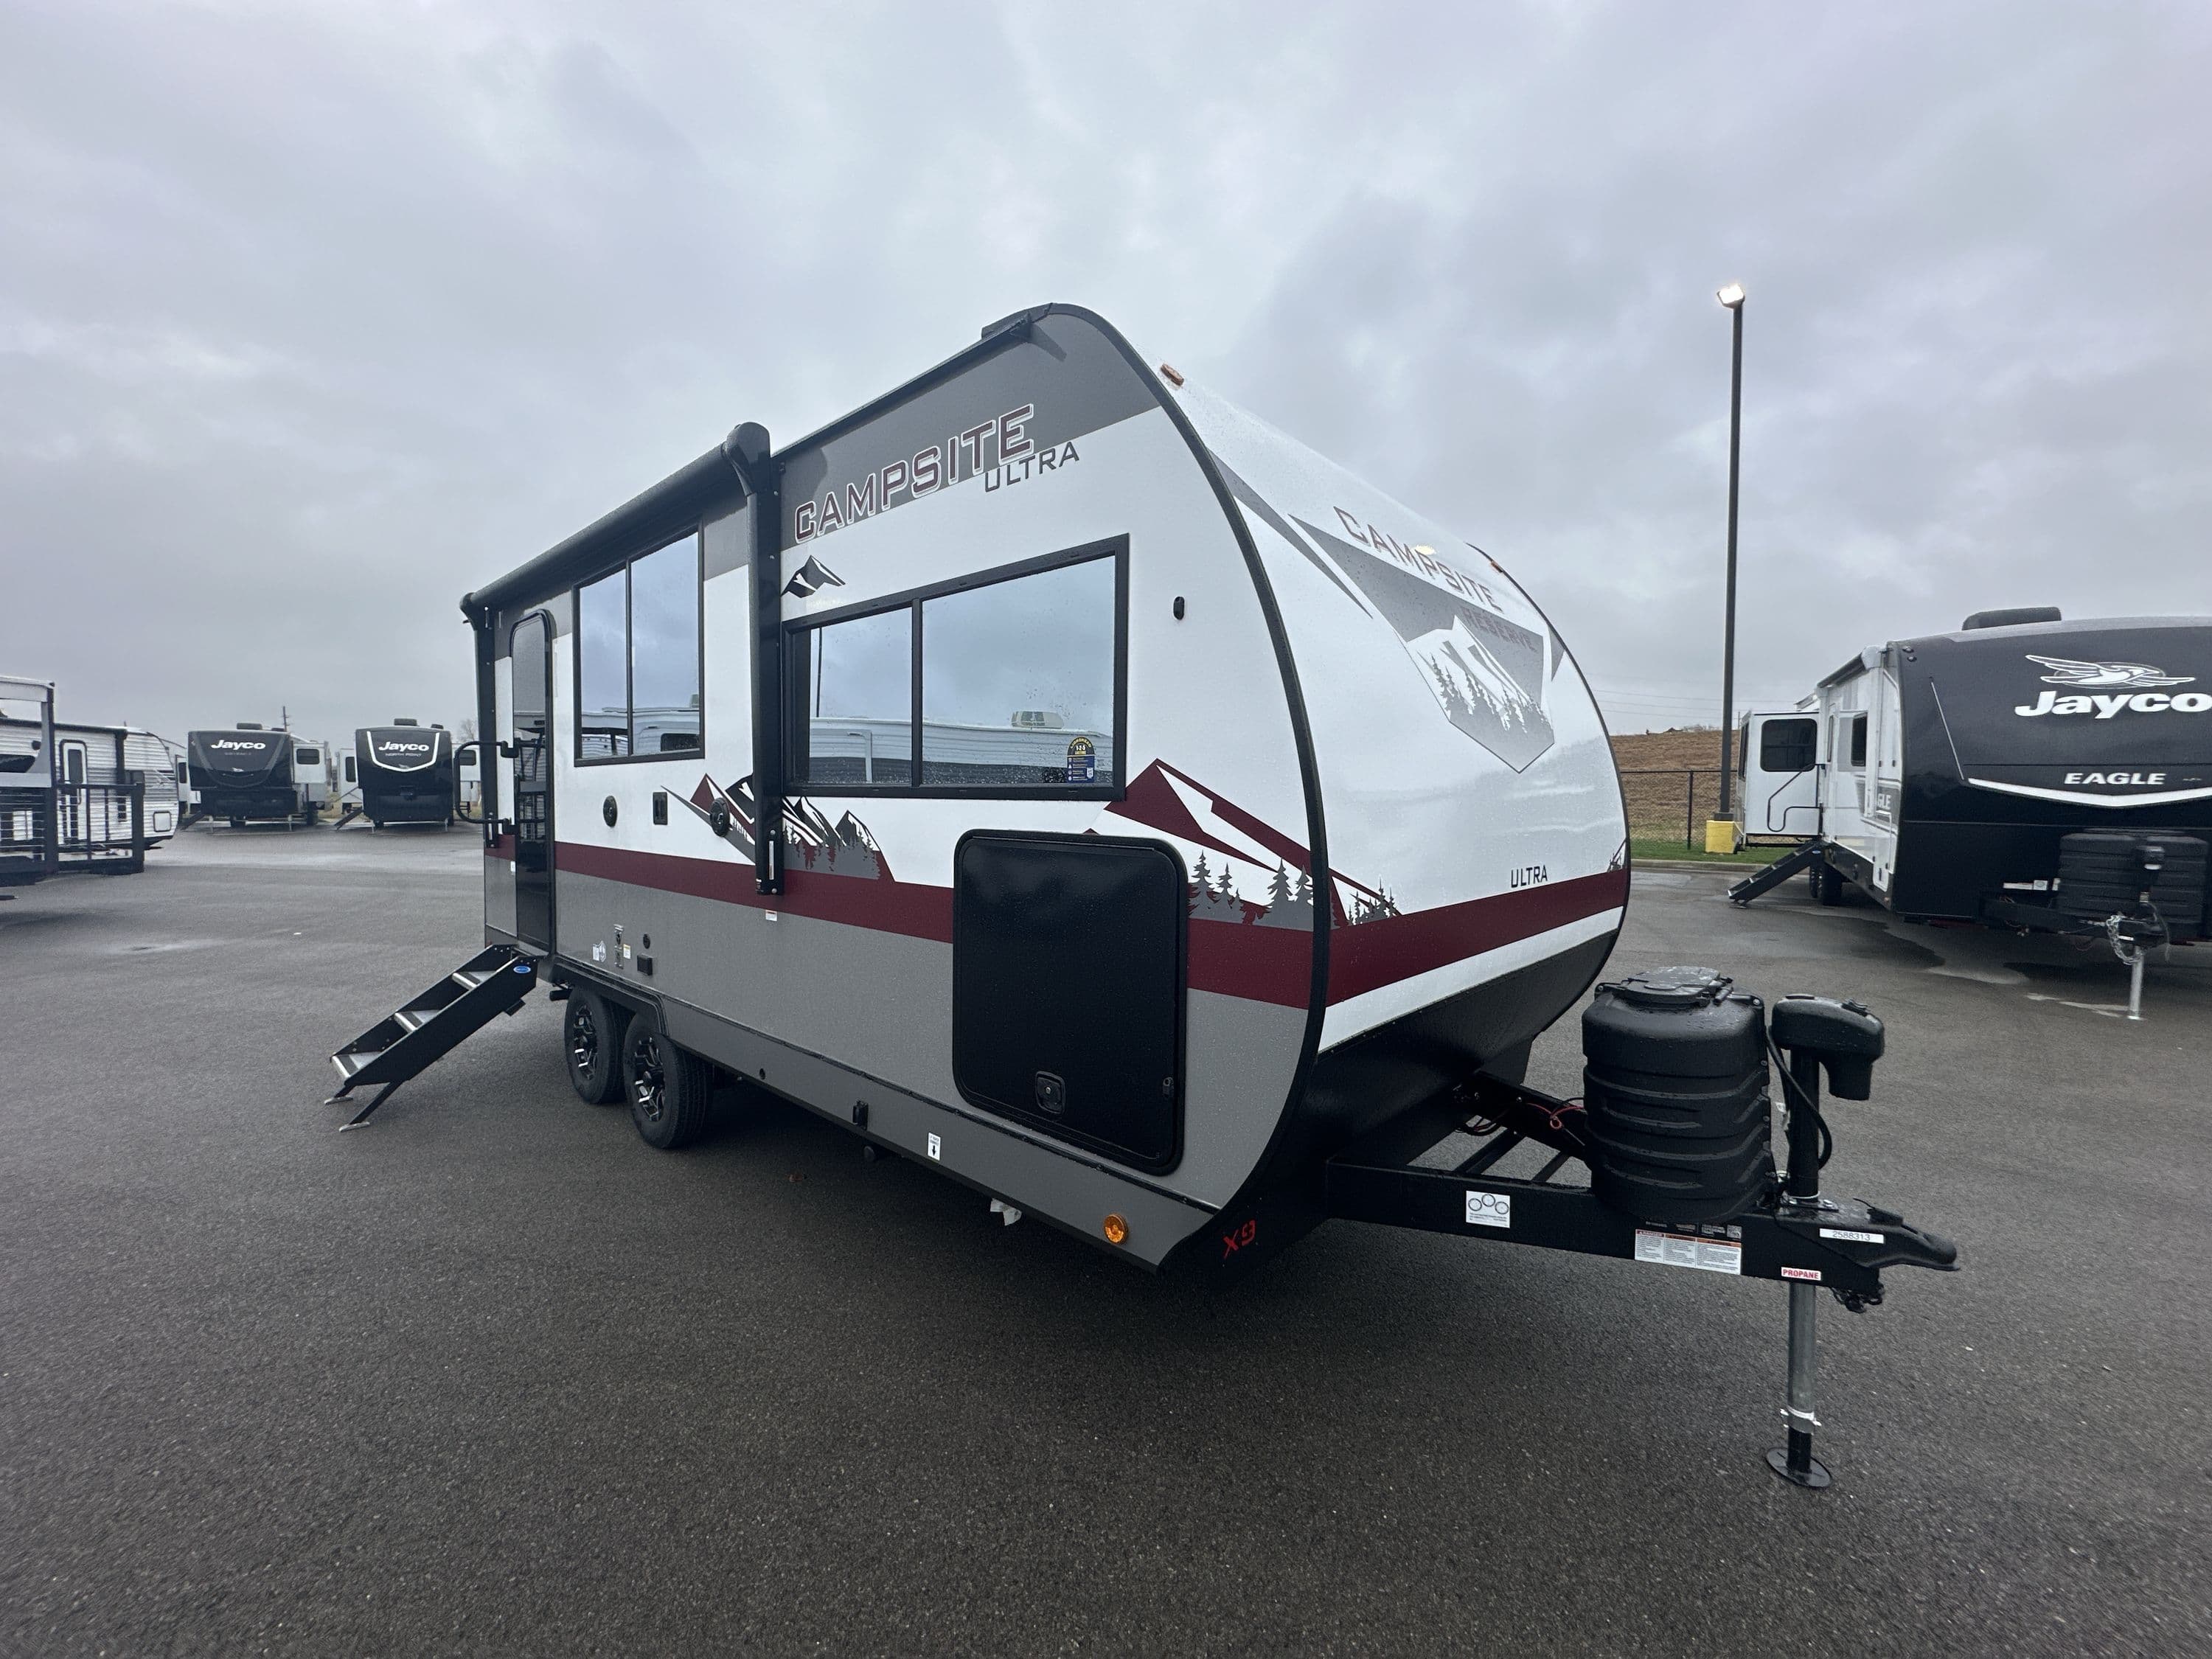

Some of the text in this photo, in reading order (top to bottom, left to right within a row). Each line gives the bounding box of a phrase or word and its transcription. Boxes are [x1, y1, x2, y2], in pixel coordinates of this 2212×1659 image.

[795, 403, 1034, 543] CAMPSITE
[985, 442, 1079, 493] ULTRA
[1333, 506, 1503, 613] CAMPSITE
[2014, 690, 2212, 719] Jayco
[211, 740, 266, 751] Jayco
[378, 741, 430, 752] Jayco
[2065, 773, 2166, 785] EAGLE
[1511, 864, 1548, 888] ULTRA
[1832, 1231, 1871, 1241] 2588313
[1783, 1269, 1819, 1279] PROPANE
